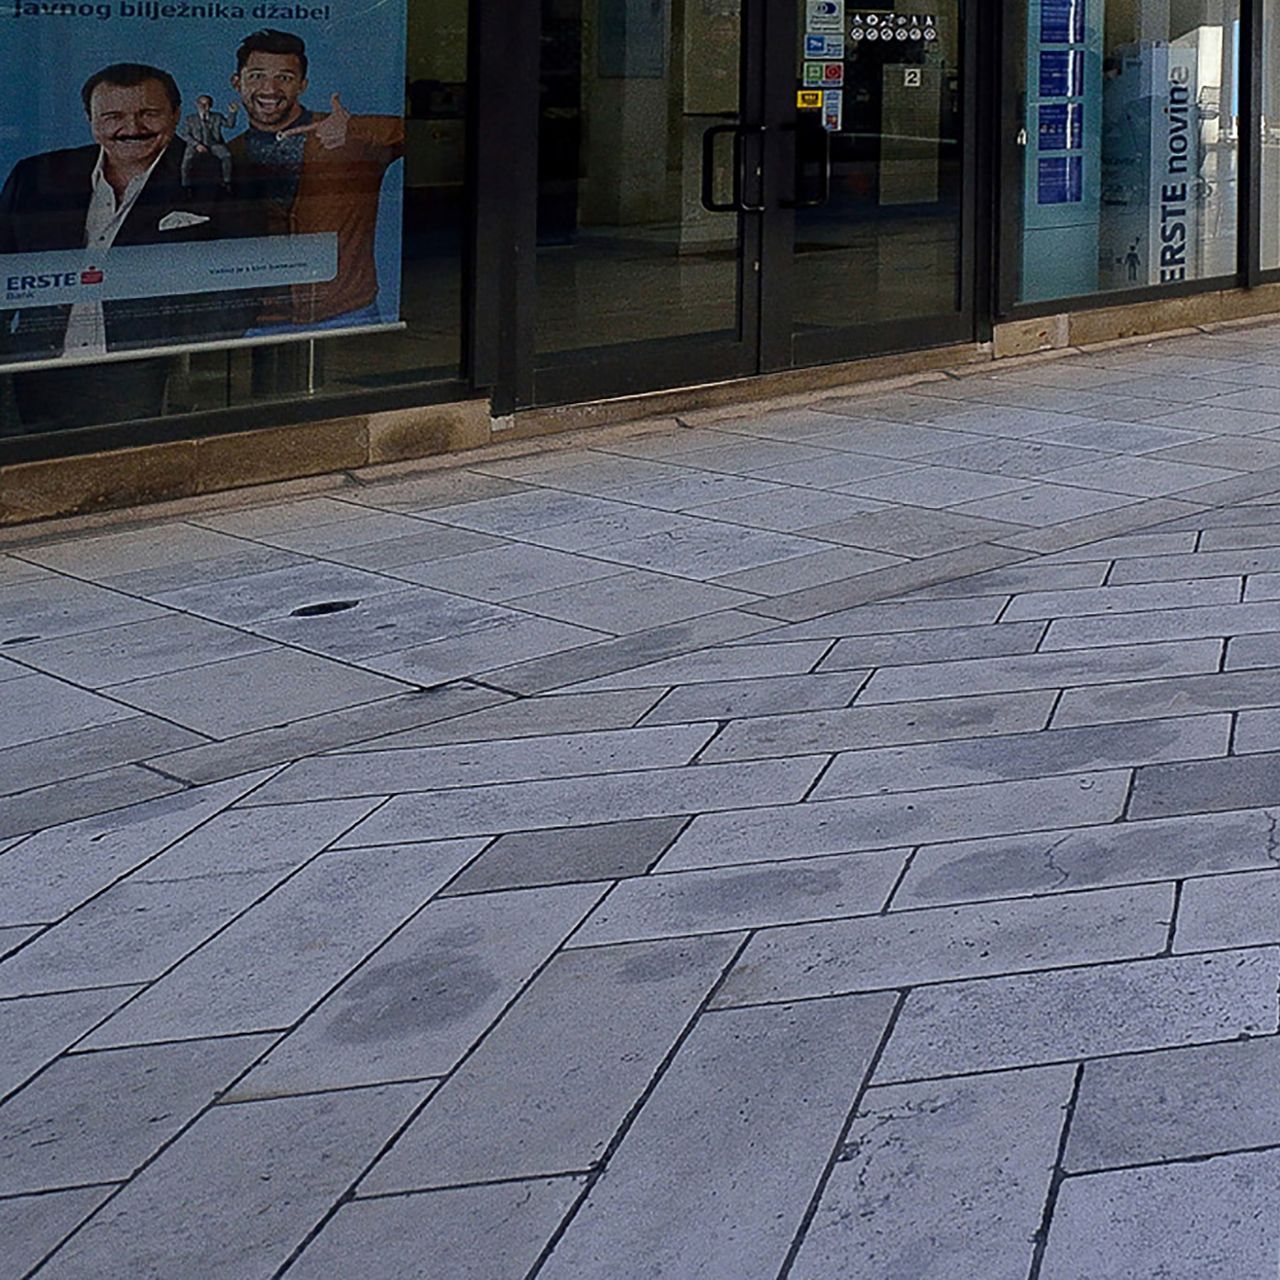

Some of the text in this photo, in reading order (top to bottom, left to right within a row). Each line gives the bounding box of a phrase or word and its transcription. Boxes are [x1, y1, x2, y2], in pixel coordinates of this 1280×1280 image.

[118, 0, 246, 22] bilježnika
[250, 3, 331, 22] džabe!
[906, 70, 919, 84] 2
[1160, 65, 1190, 284] ERSTE novine
[6, 271, 78, 291] ERSTE
